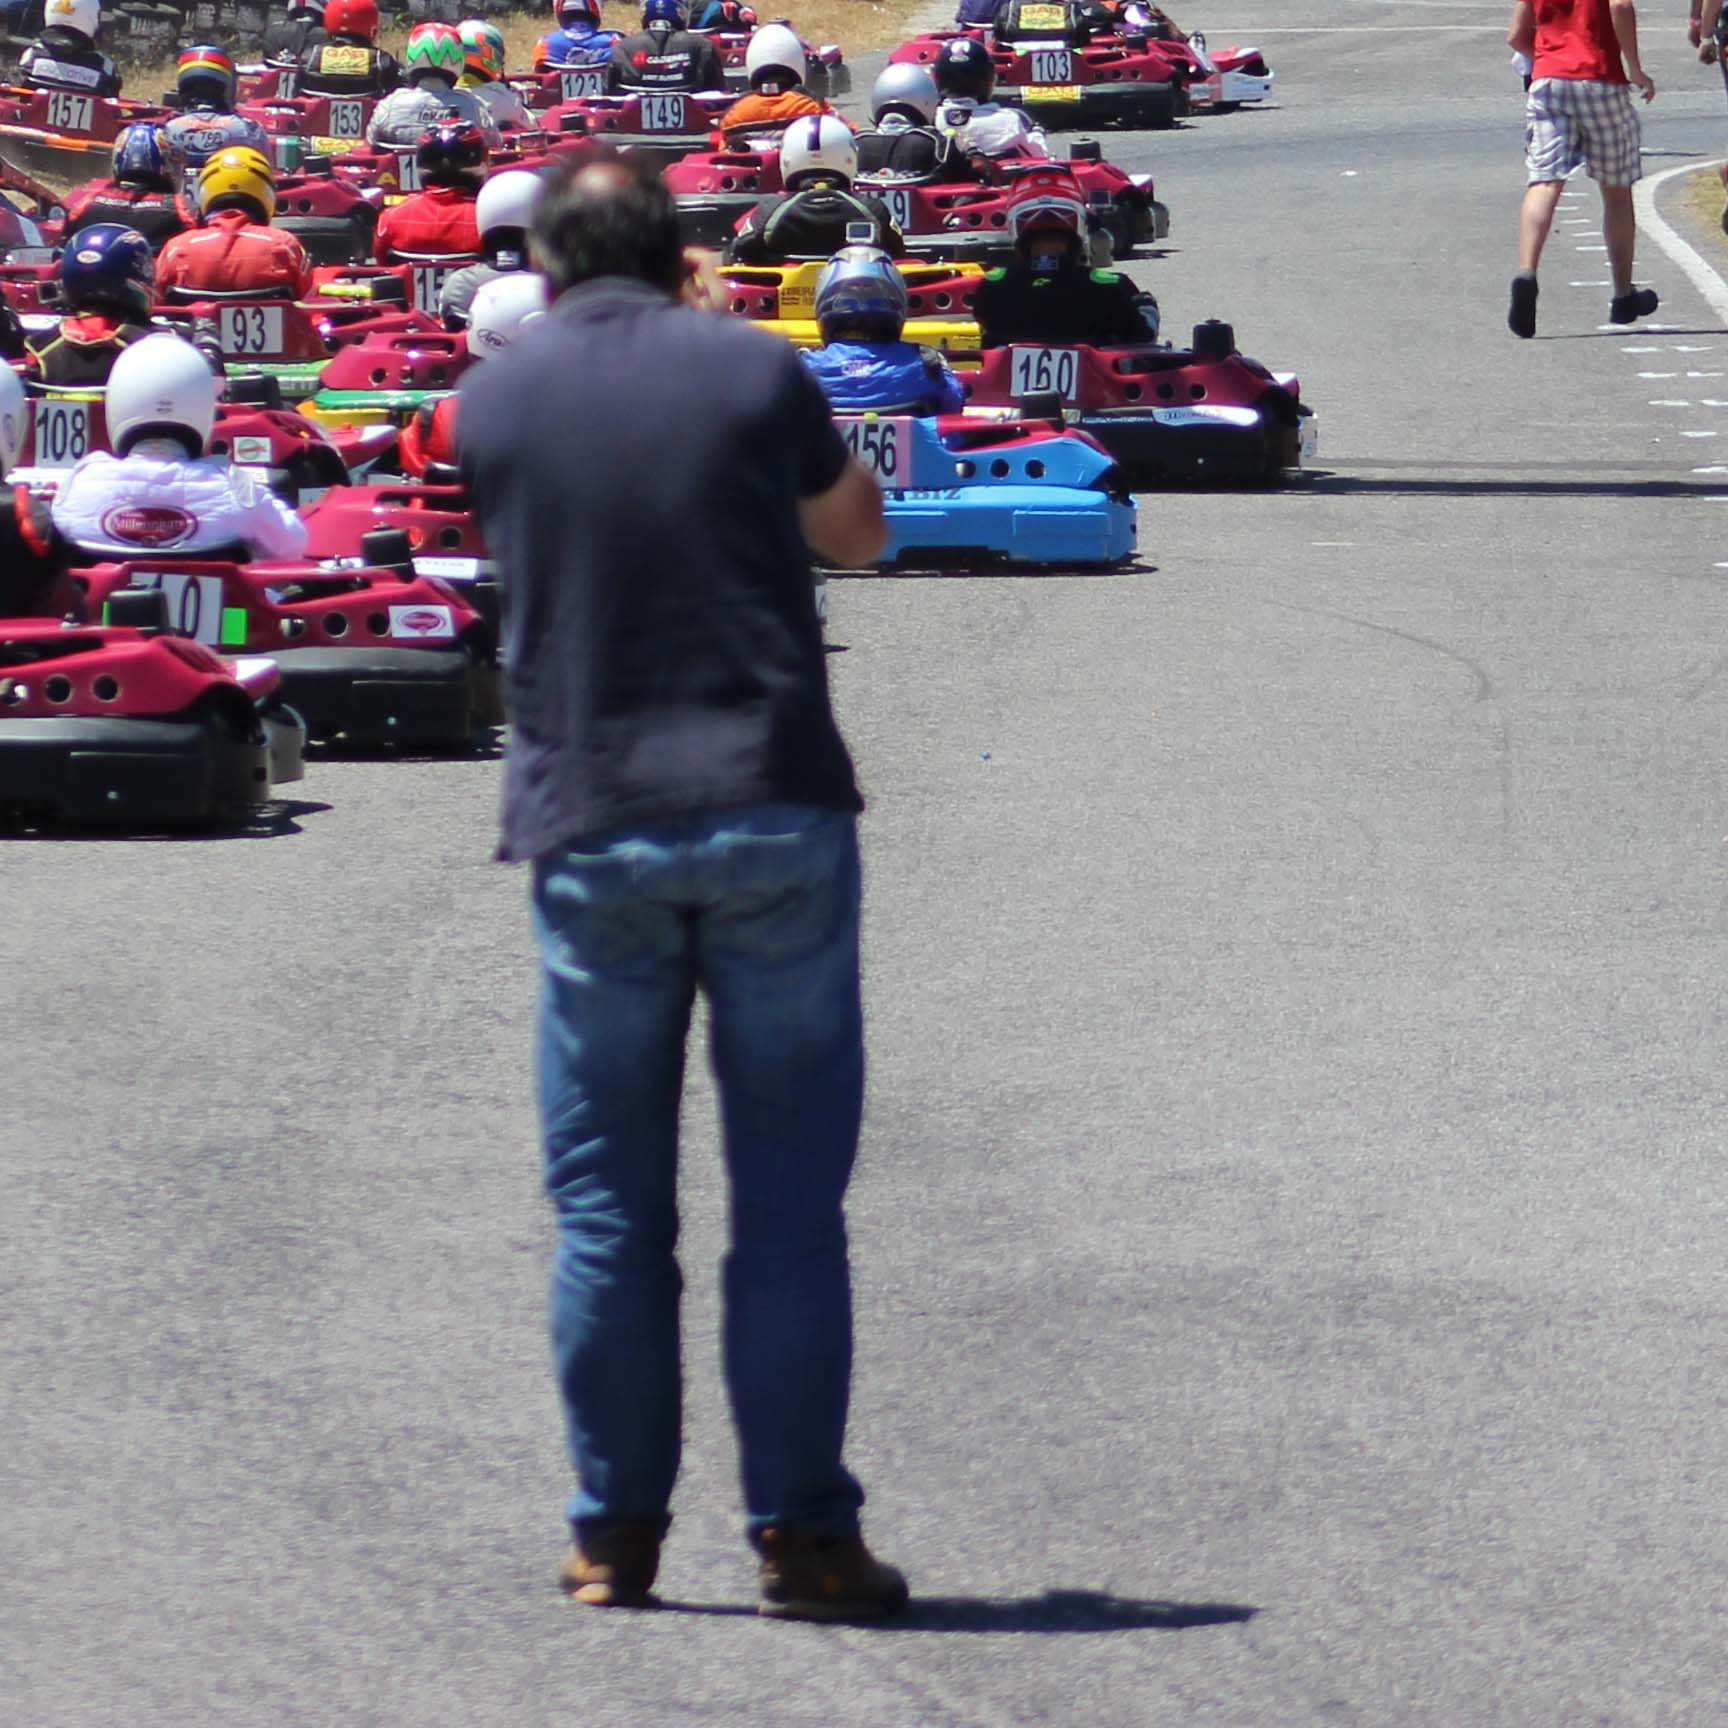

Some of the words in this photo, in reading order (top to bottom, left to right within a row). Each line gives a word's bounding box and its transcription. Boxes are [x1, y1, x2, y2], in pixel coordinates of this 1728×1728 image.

[1036, 52, 1069, 81] 103
[563, 73, 598, 100] 123
[51, 92, 87, 130] 157
[331, 104, 360, 134] 153
[644, 98, 682, 127] 149
[232, 307, 266, 353] 93
[1018, 349, 1072, 399] 160
[36, 407, 86, 462] 108
[846, 423, 897, 477] 156
